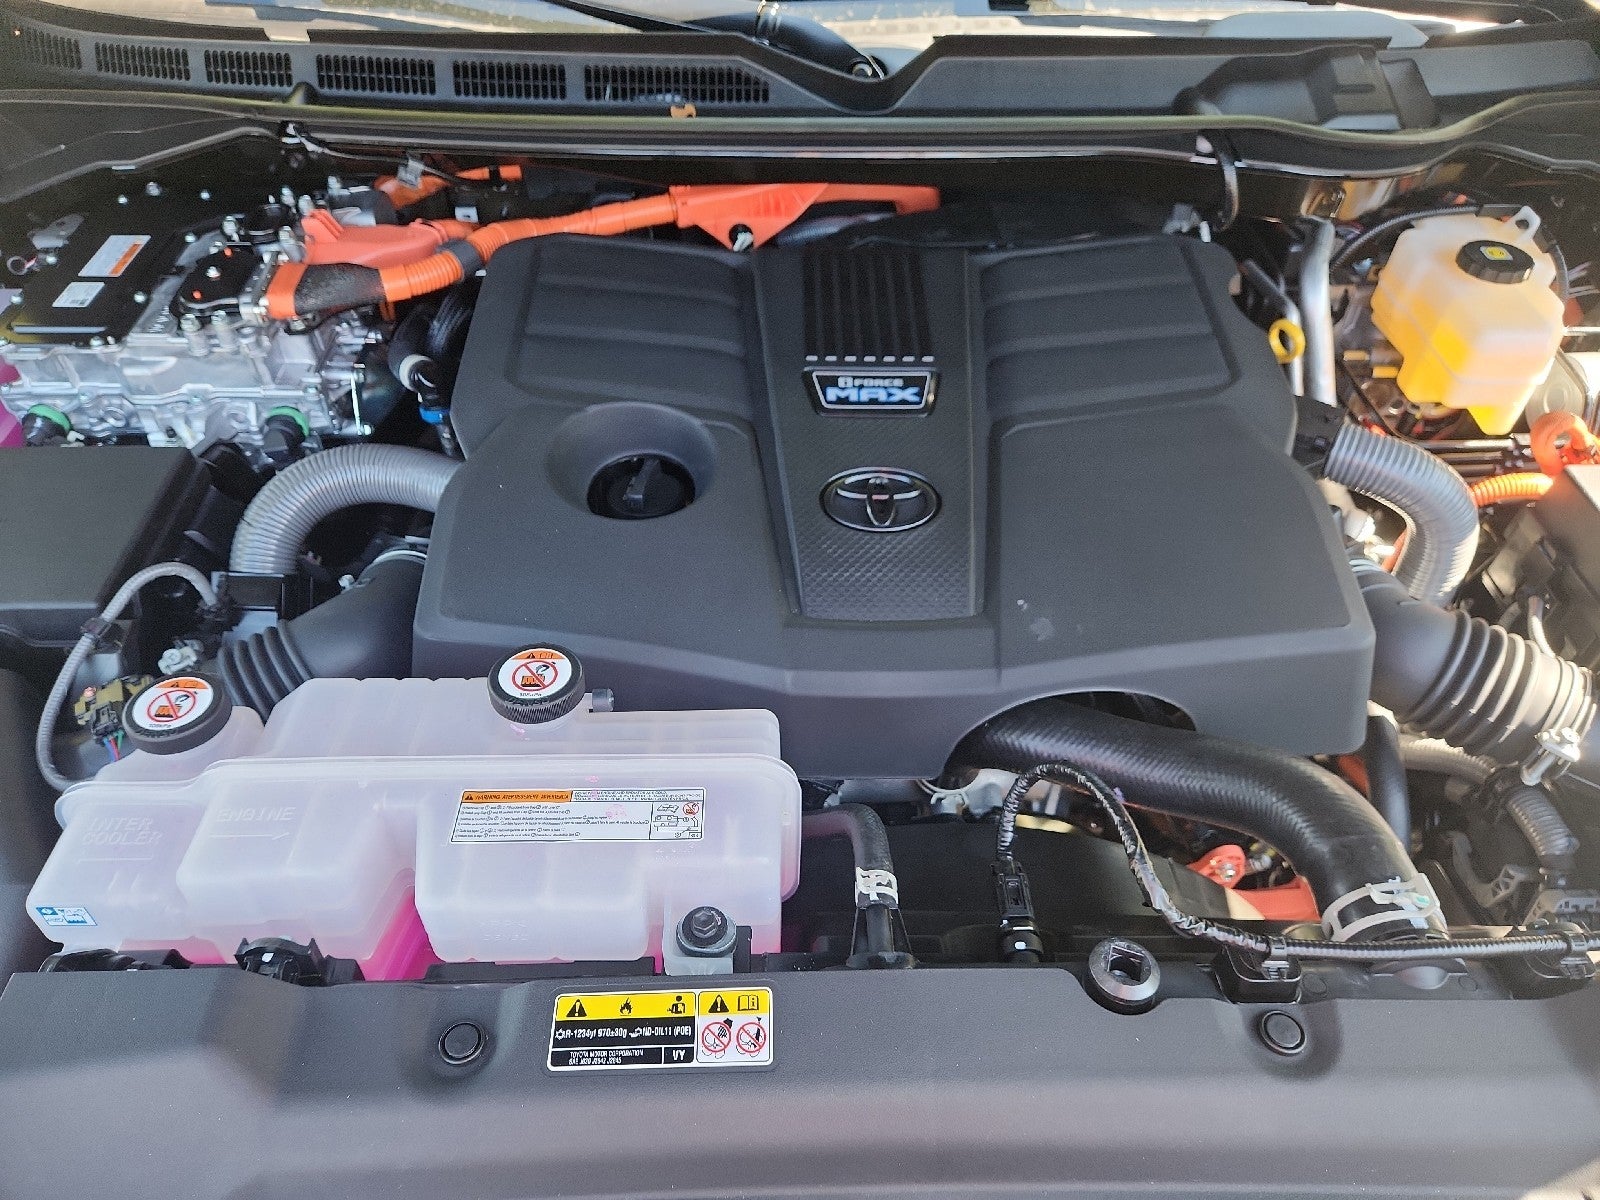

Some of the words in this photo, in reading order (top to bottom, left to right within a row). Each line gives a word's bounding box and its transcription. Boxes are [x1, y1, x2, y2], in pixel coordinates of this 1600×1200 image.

[825, 386, 921, 402] MAX
[217, 806, 297, 822] ENGINE
[673, 1025, 692, 1037] (POE)
[570, 1051, 589, 1059] TOYOTA
[589, 1050, 608, 1058] MOTOR
[608, 1048, 644, 1057] CORPORATION
[672, 1049, 686, 1061] VY
